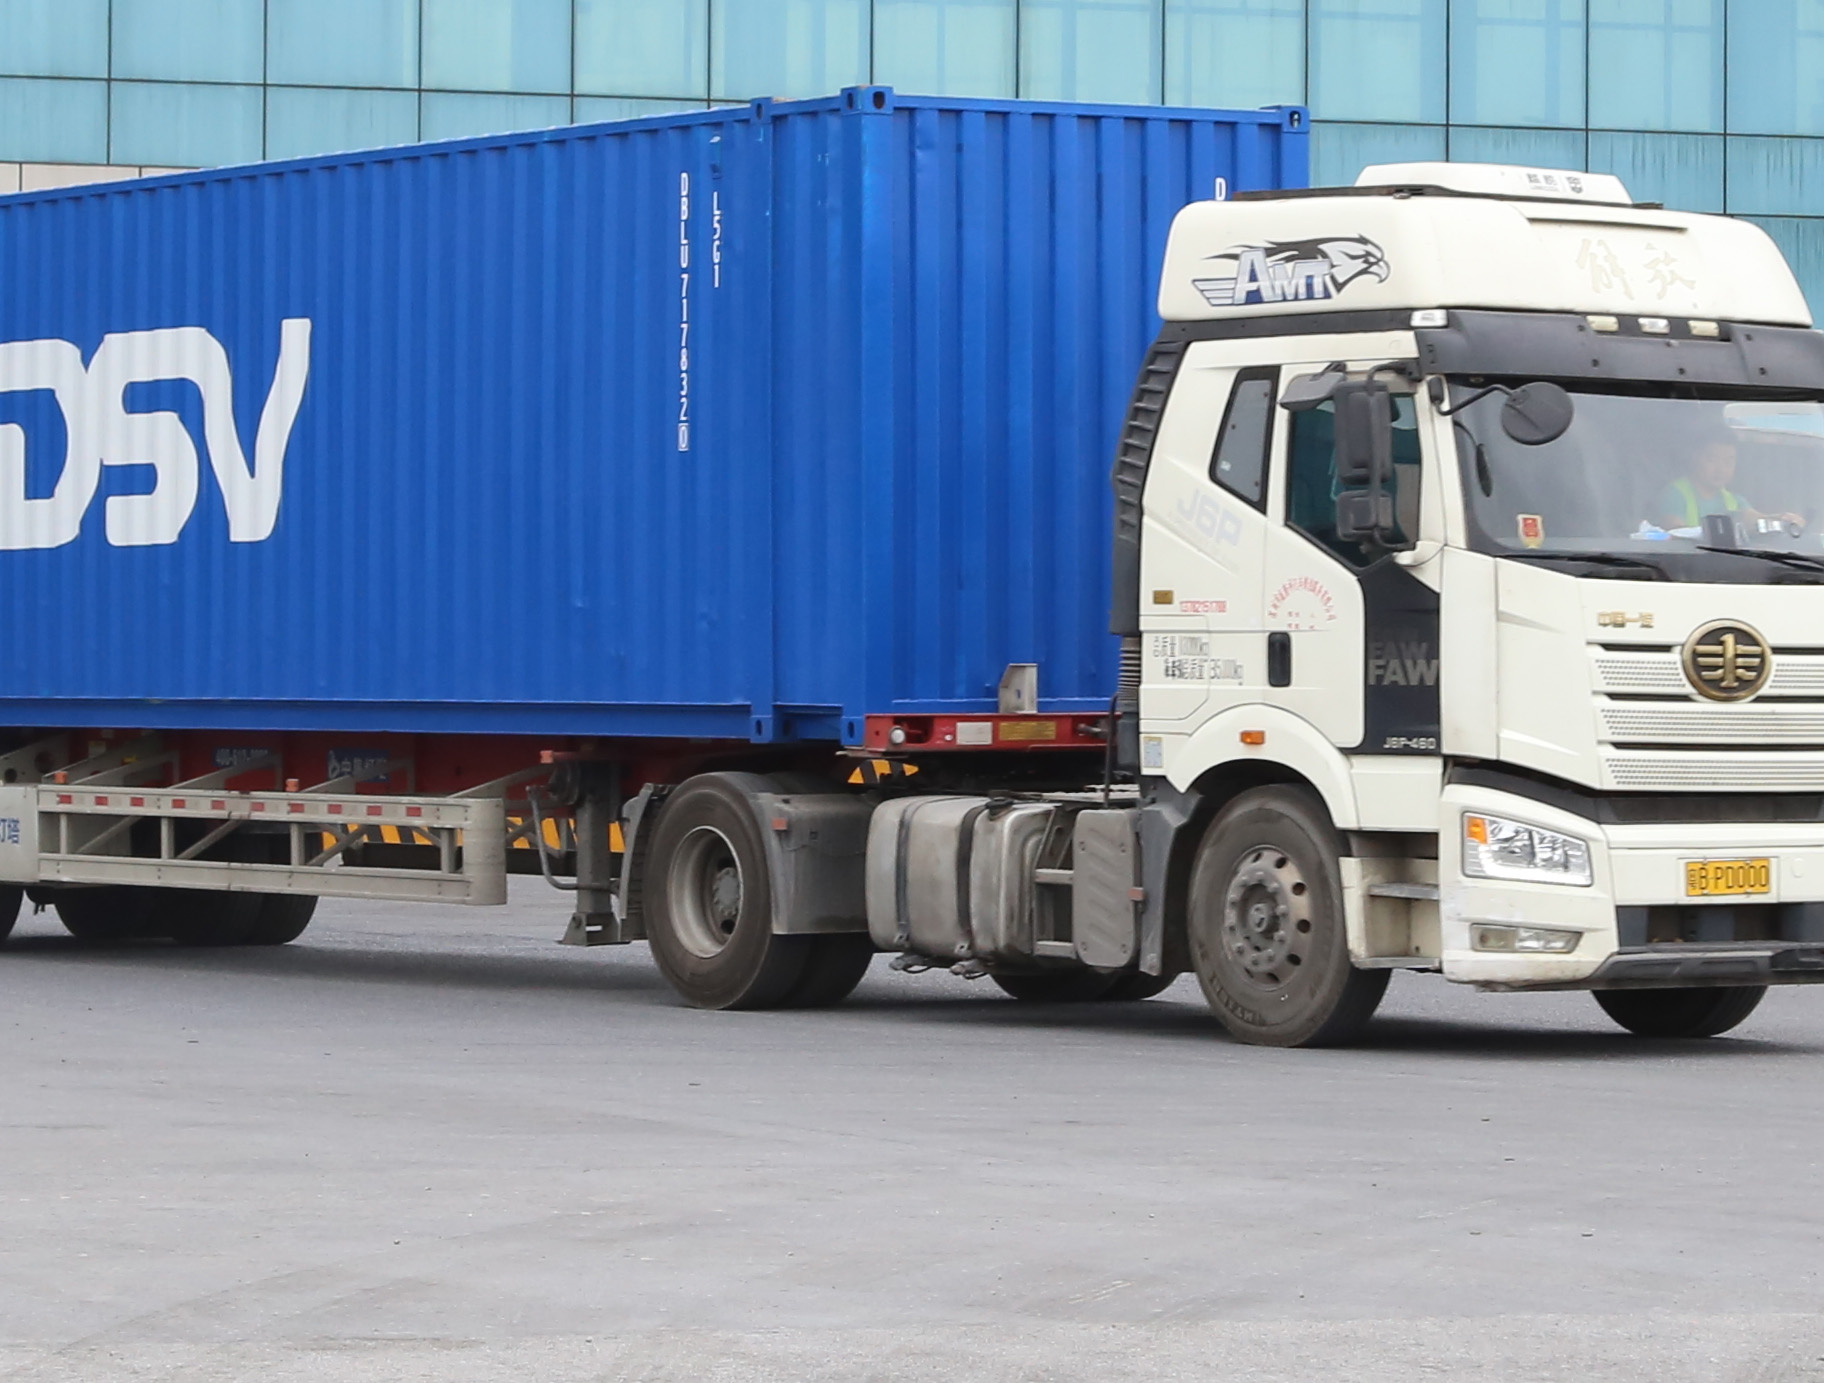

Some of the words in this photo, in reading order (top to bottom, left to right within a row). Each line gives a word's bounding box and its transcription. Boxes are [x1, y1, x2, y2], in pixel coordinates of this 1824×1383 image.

[679, 171, 690, 270] DBLU
[712, 190, 722, 289] L5G1
[1232, 248, 1332, 305] AMT
[1177, 489, 1243, 546] J6P
[1368, 659, 1439, 685] FAW
